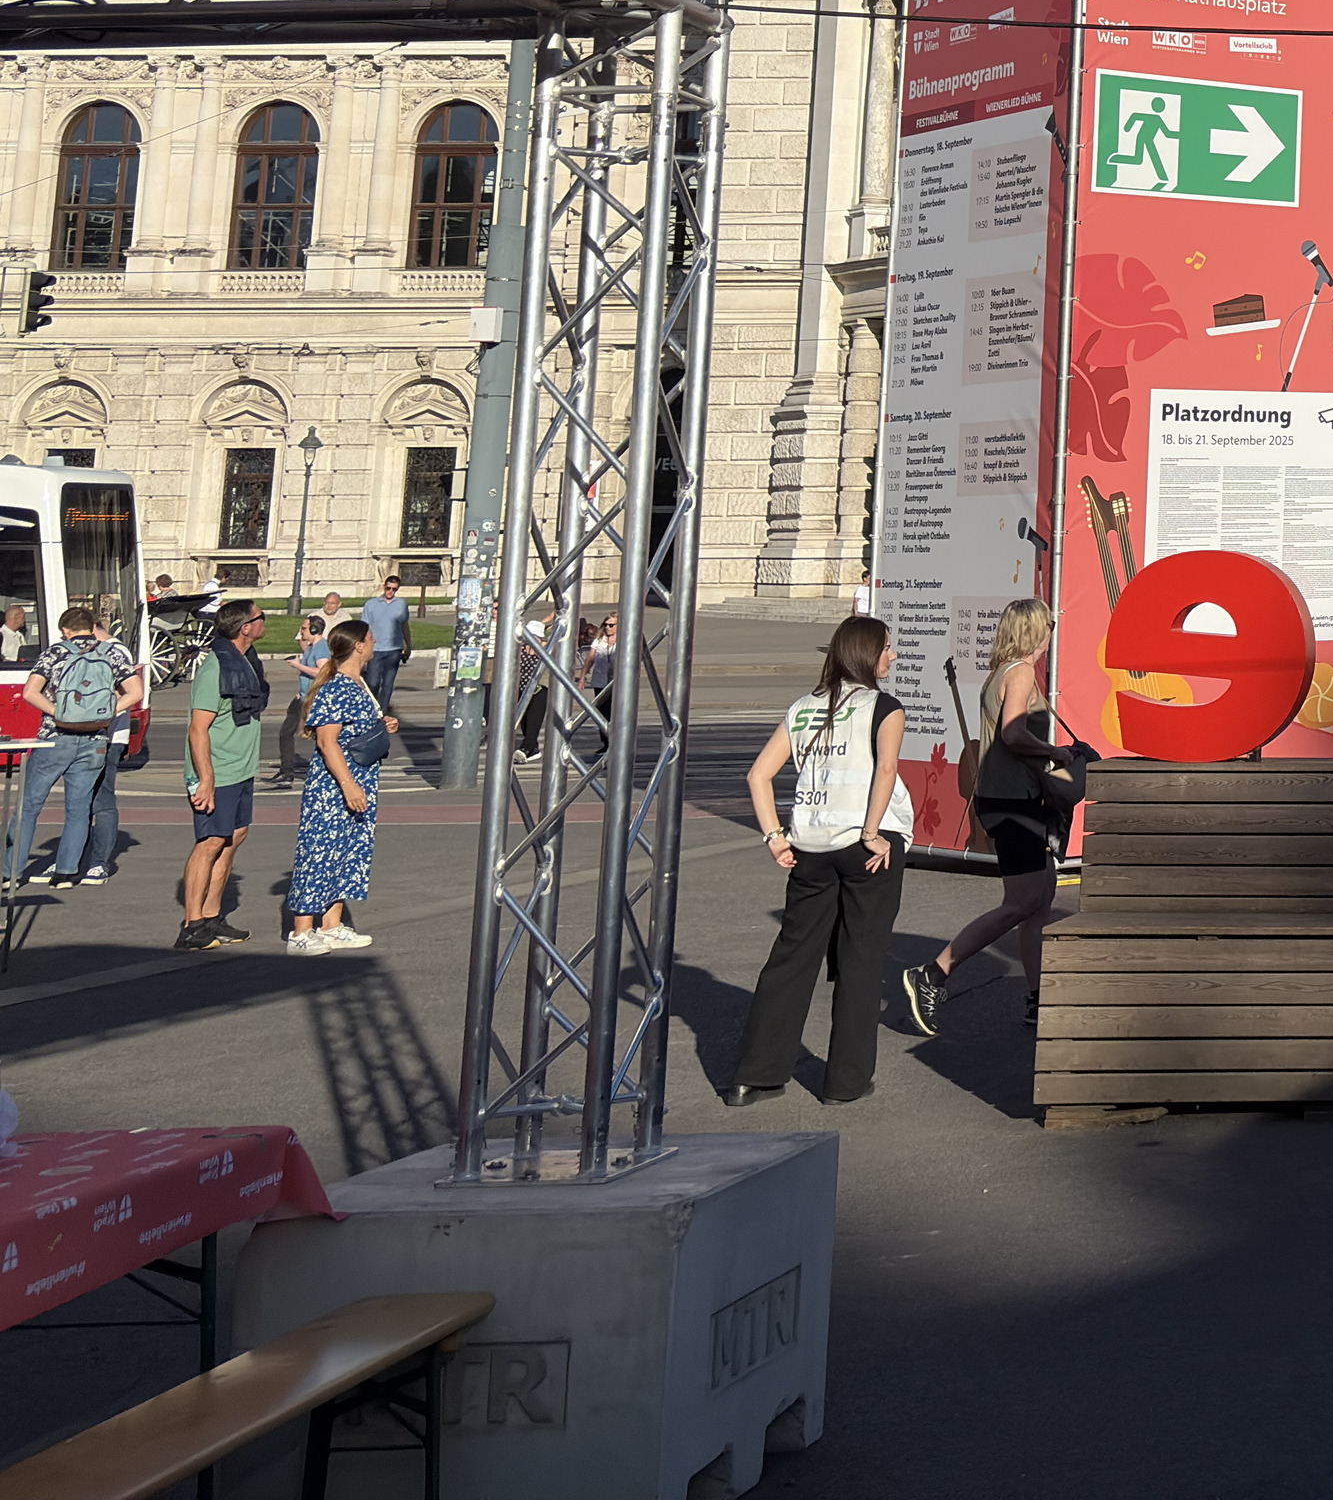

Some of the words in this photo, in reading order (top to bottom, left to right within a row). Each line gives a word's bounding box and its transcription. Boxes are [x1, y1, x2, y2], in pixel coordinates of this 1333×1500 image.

[924, 28, 939, 39] Stadt
[1097, 31, 1129, 45] Wien
[1154, 32, 1190, 45] WKO
[924, 41, 939, 52] Wien
[909, 61, 1015, 100] Bühnenprogramm
[986, 97, 1020, 112] WIENERLIED
[1021, 92, 1041, 105] BÜHNE
[916, 111, 958, 128] FESTIVALBÜHNE
[905, 145, 935, 157] Donnerstag,
[945, 137, 972, 150] September
[897, 273, 916, 283] Freitag,
[926, 267, 953, 280] September
[890, 412, 913, 423] Samstag,
[923, 409, 951, 422] September
[1162, 403, 1292, 428] Platzordnung
[1162, 434, 1175, 445] 18.
[1179, 434, 1192, 445] bis
[1195, 435, 1208, 445] 21.
[1211, 435, 1266, 447] September
[1269, 436, 1294, 446] 2025
[882, 581, 904, 590] Sonntag,
[914, 579, 942, 591] September
[795, 791, 828, 805] S301
